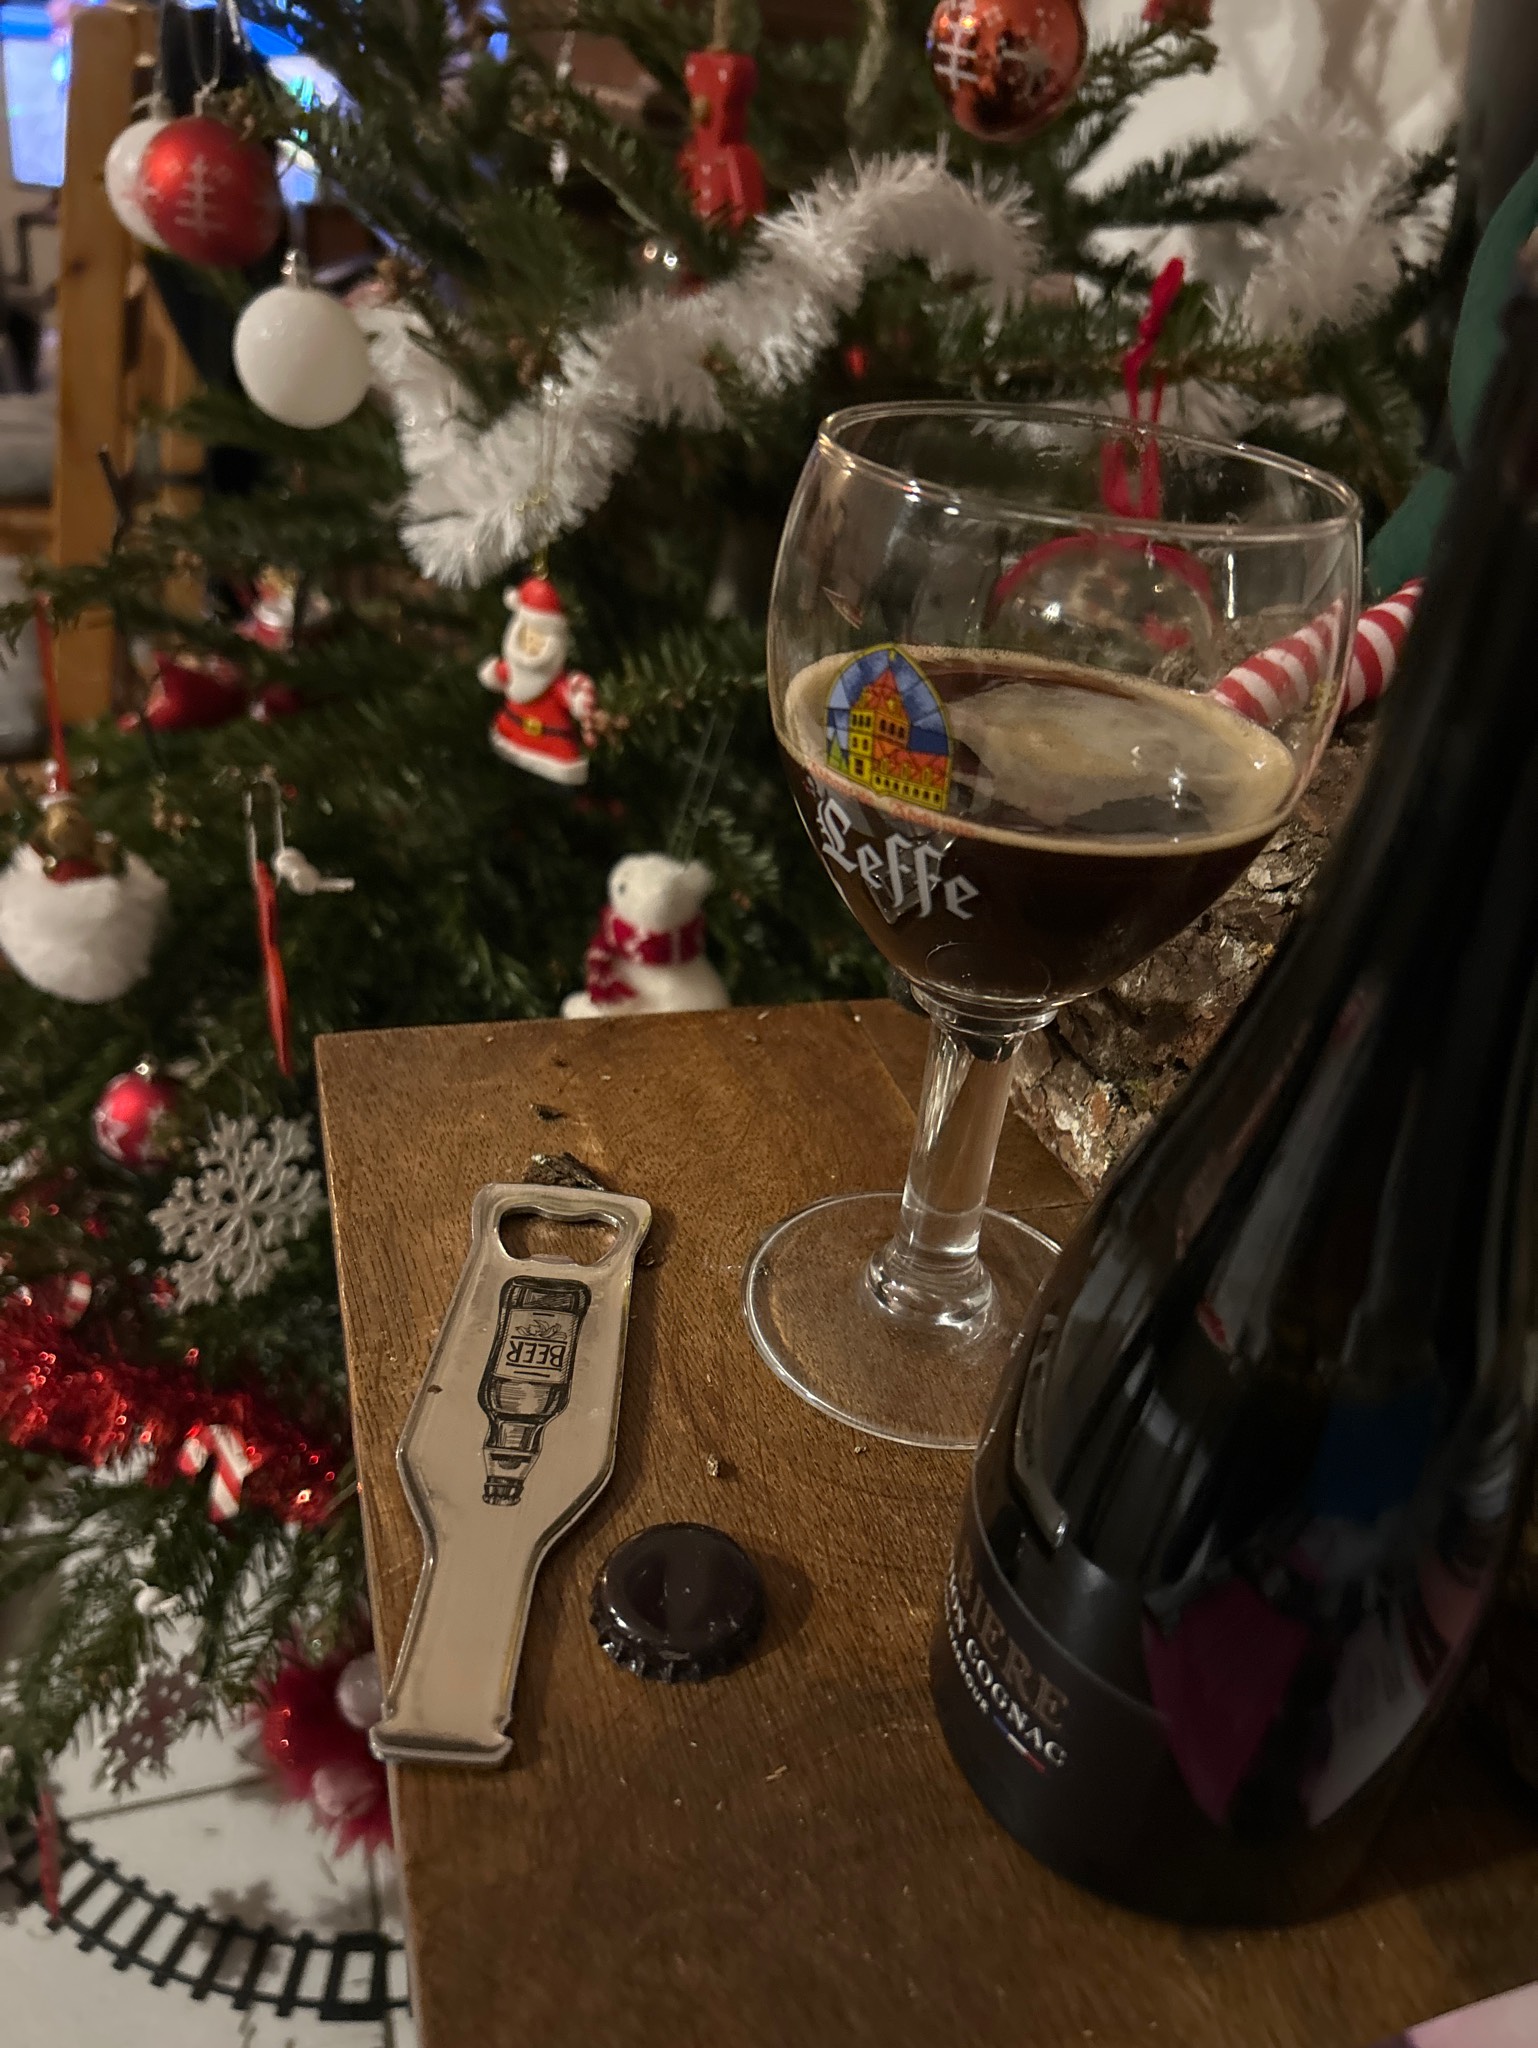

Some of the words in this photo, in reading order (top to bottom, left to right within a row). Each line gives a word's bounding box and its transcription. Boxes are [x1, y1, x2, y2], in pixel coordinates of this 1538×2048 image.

[815, 797, 980, 921] Leffe
[506, 1340, 568, 1368] BEER
[965, 1637, 1068, 1768] COGNAC
